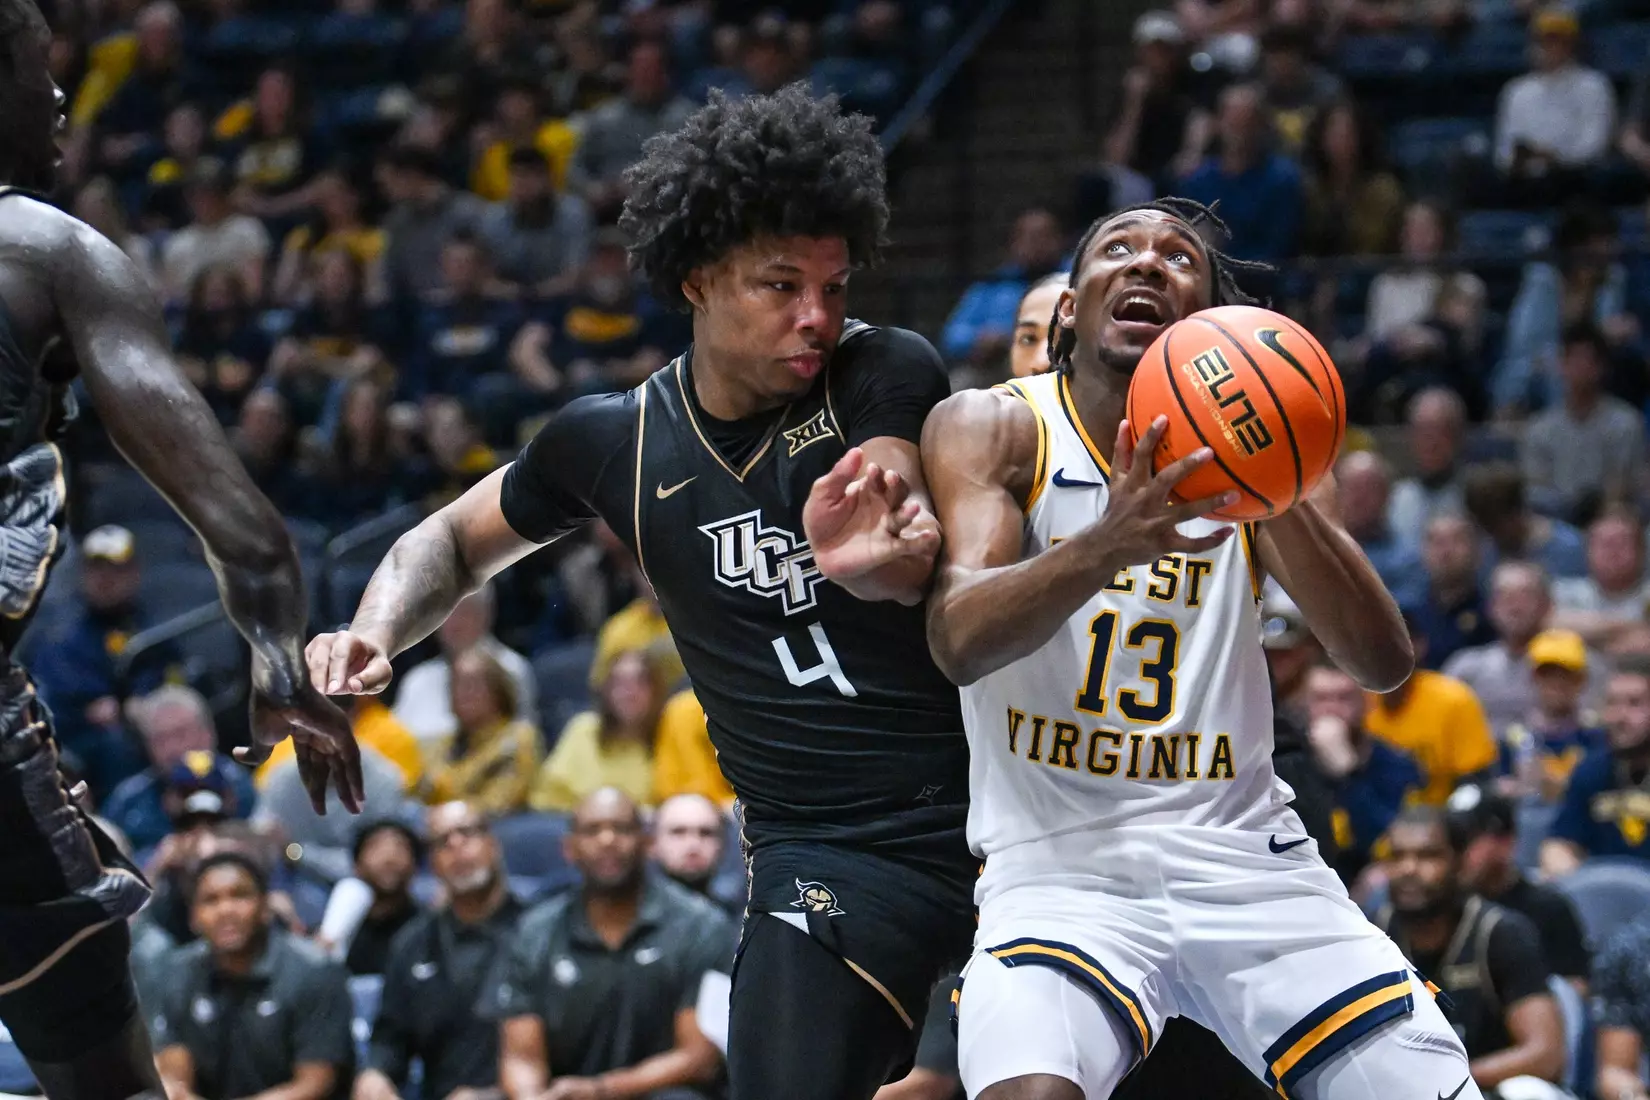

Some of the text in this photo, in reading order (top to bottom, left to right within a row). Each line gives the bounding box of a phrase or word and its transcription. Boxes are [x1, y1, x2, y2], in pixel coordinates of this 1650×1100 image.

[1181, 363, 1249, 461] CHAMIONSHI
[1191, 345, 1275, 456] ELITE
[697, 509, 828, 616] UCF
[771, 621, 859, 697] 4
[1074, 609, 1182, 725] 13
[1007, 704, 1236, 781] VIRGINIA
